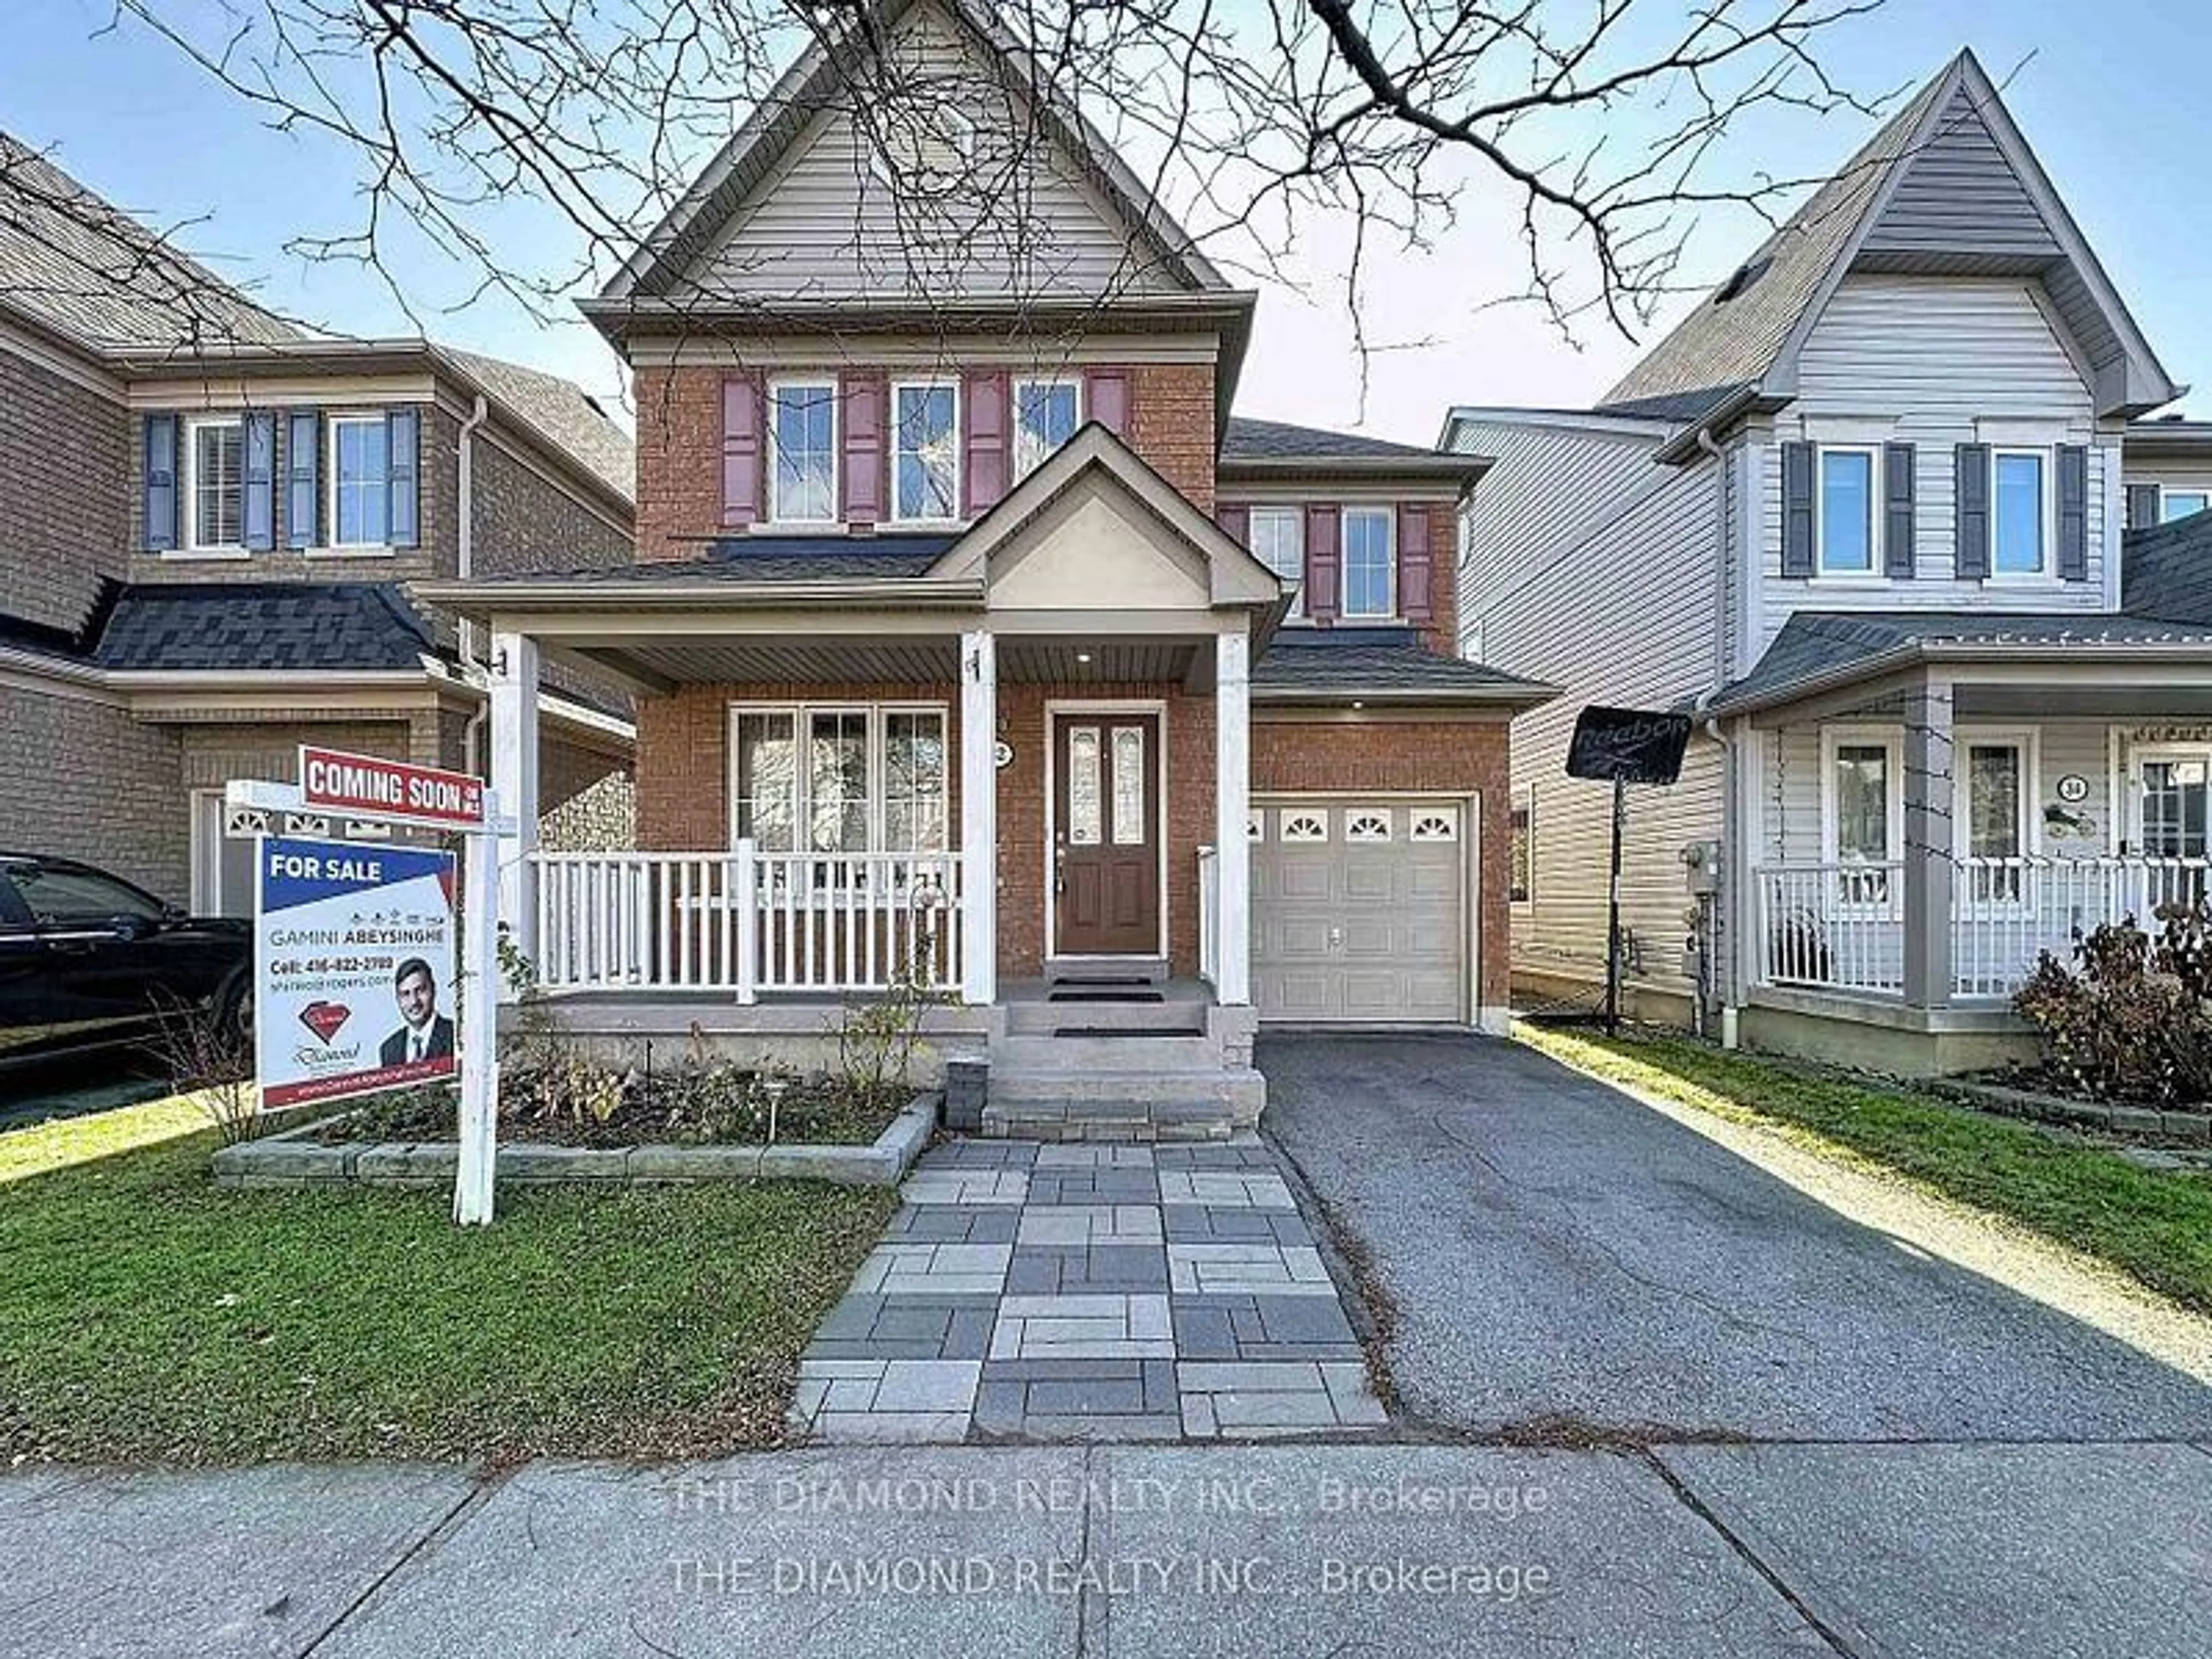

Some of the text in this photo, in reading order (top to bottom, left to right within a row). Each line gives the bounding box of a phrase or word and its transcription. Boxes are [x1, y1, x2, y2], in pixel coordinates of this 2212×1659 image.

[309, 759, 460, 812] COMING SOON
[271, 854, 382, 881] FOR SALE
[268, 929, 444, 947] GAMINI ABEYSINGHE
